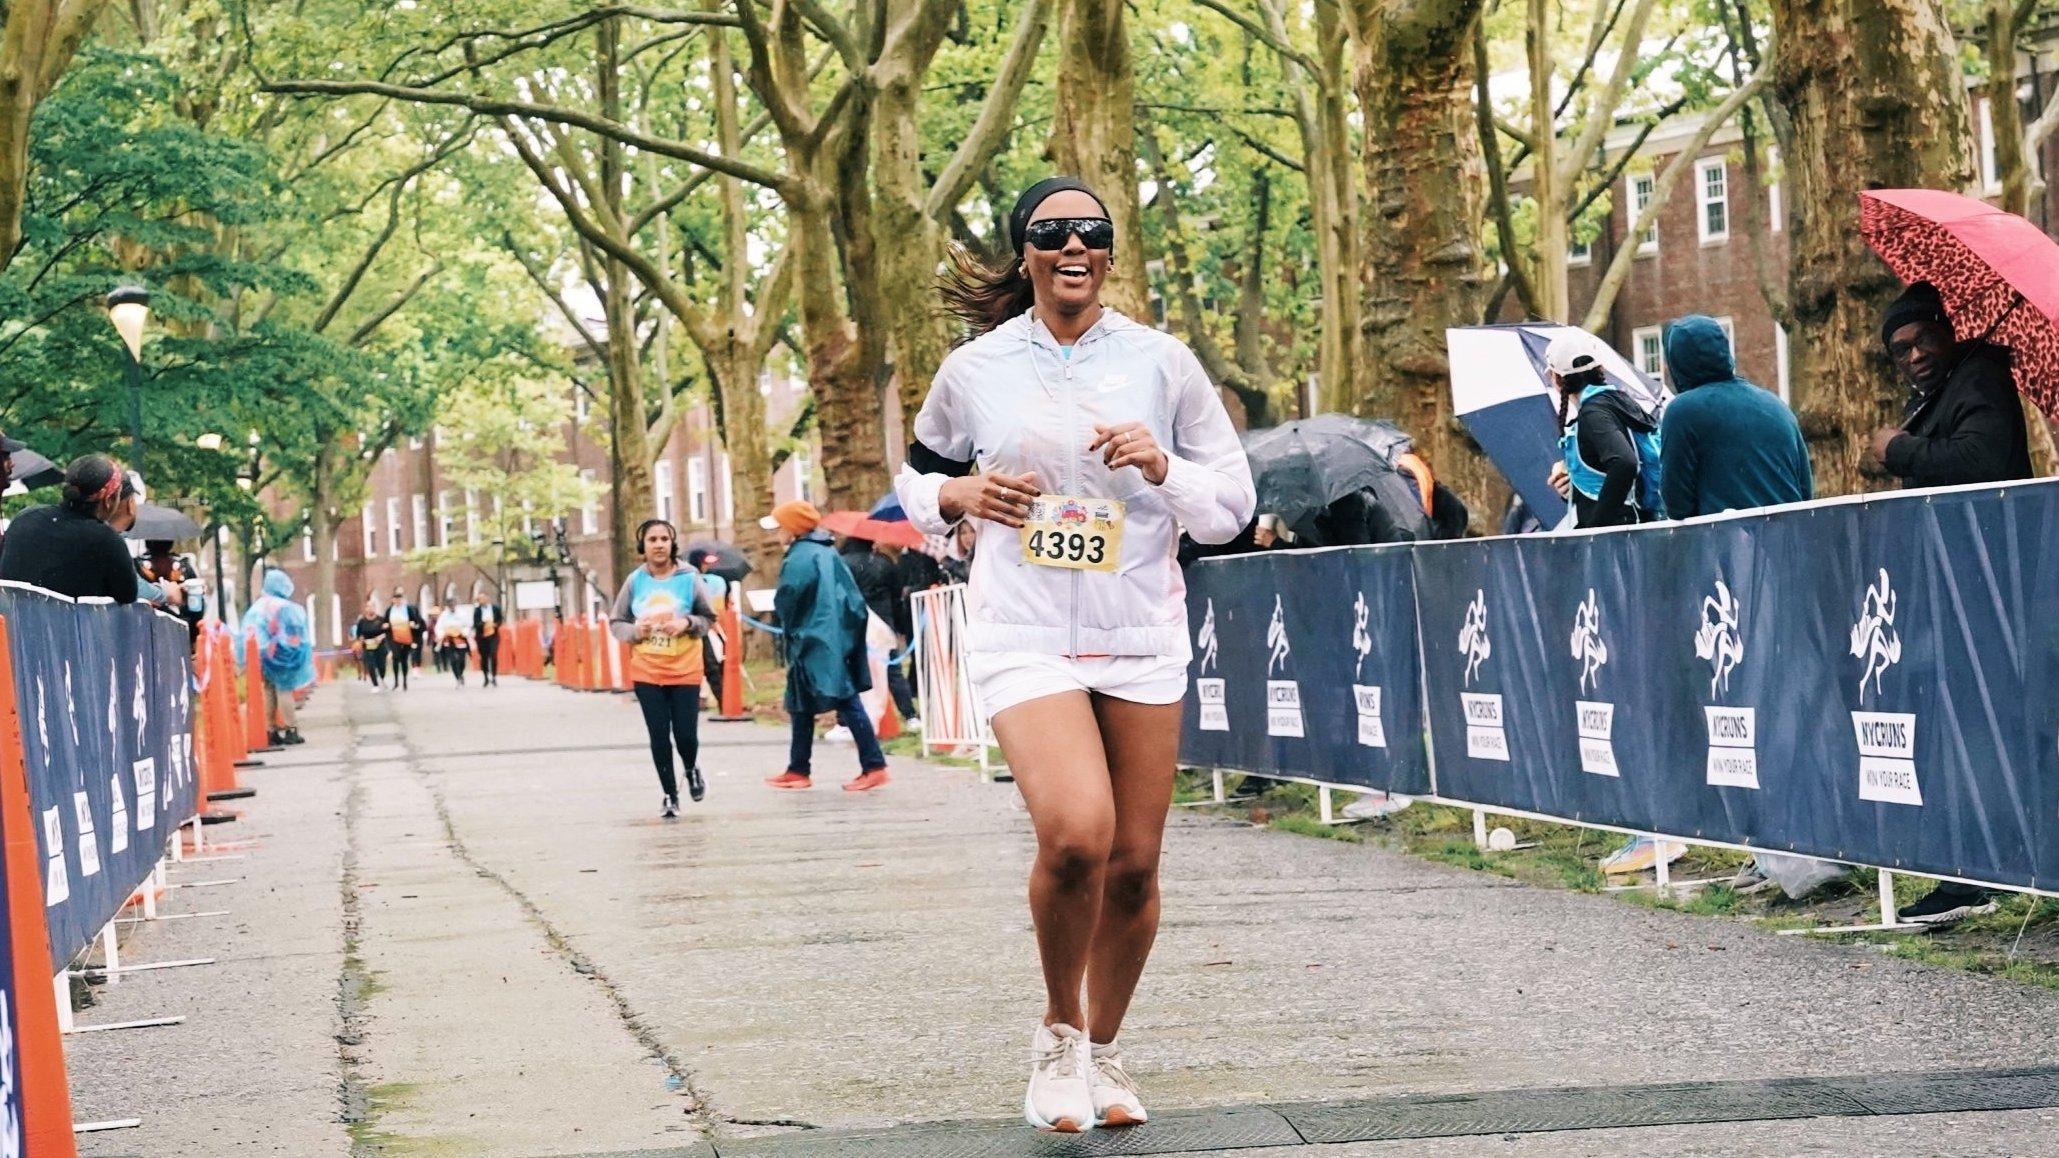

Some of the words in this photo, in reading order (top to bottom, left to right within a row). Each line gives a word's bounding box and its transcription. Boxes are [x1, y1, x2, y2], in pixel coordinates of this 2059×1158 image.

[1029, 530, 1105, 563] 4393
[1713, 715, 1748, 738] NYCRUNS
[1861, 721, 1907, 749] NYCRUNS
[1866, 769, 1878, 786] WIN
[1879, 770, 1893, 788] YOUR
[1894, 771, 1911, 790] RACE
